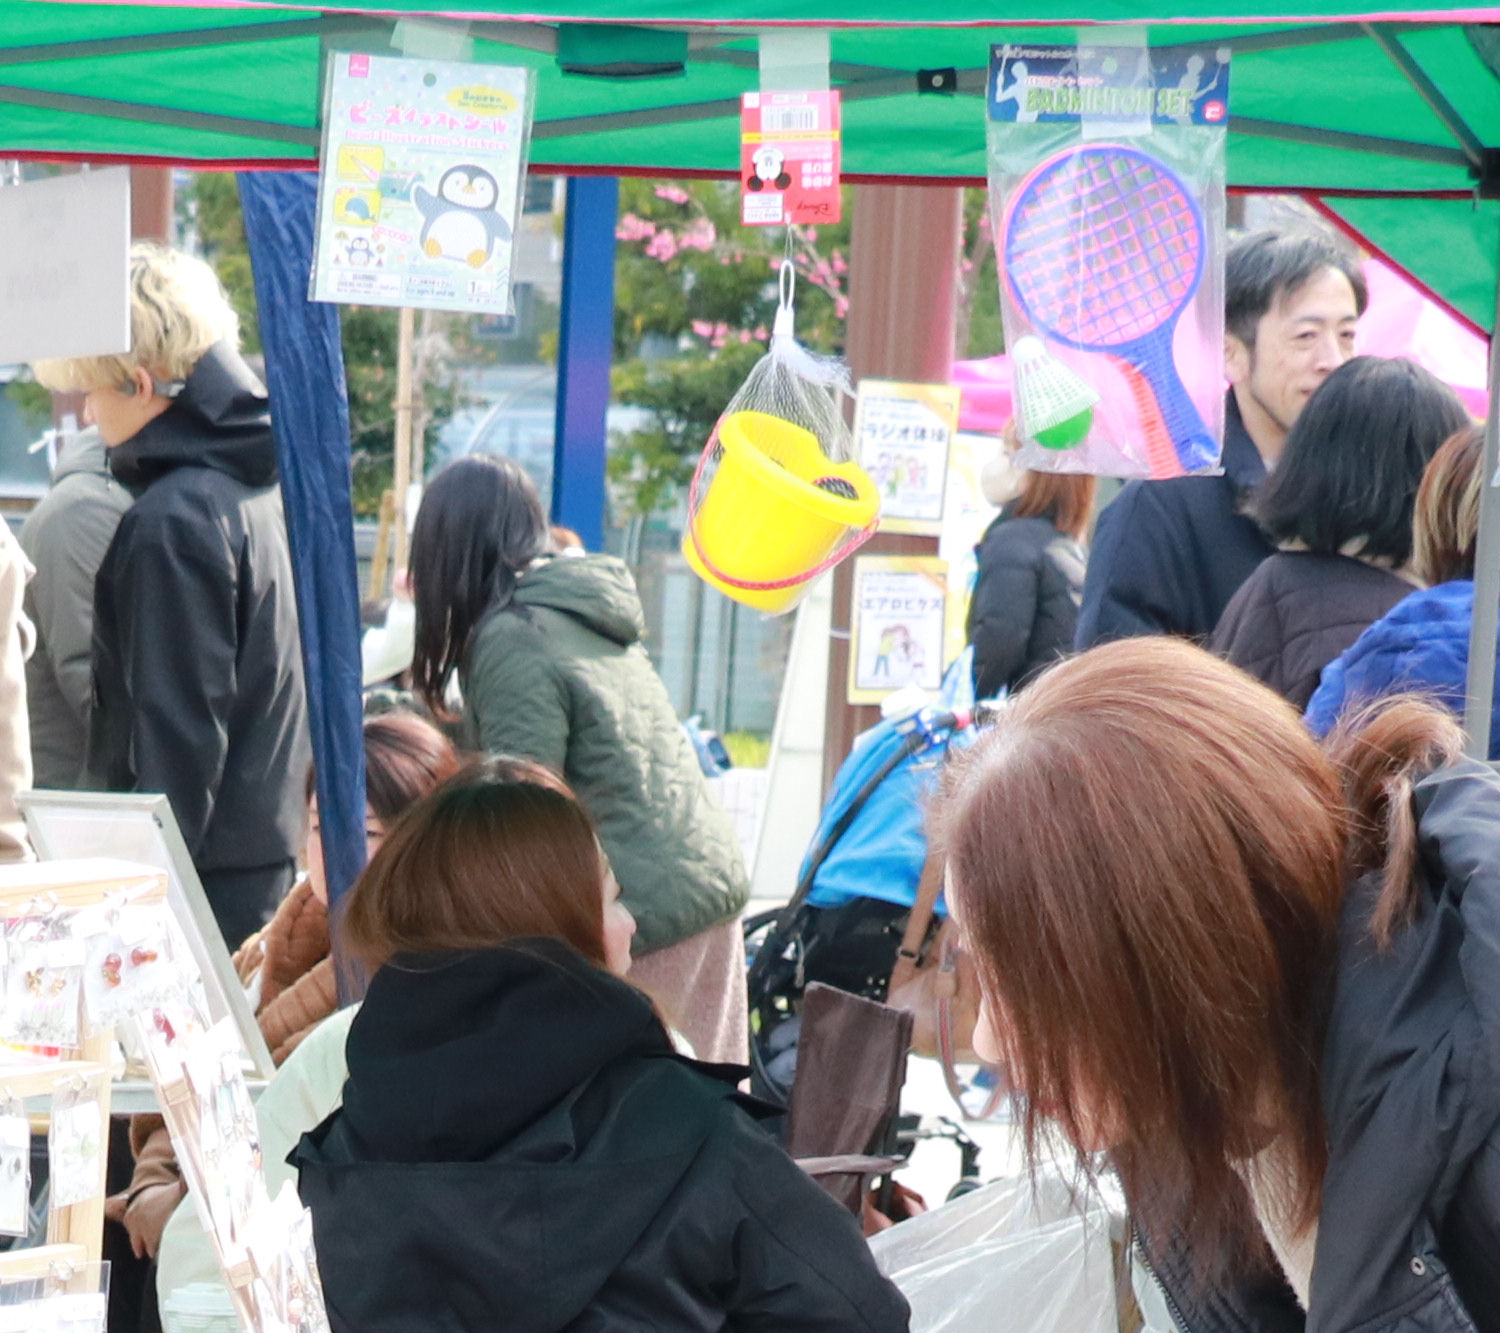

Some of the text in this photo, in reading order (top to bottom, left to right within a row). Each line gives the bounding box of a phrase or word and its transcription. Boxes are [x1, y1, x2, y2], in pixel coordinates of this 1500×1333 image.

[1024, 86, 1155, 116] BADMINTON
[1157, 87, 1194, 117] SET
[349, 101, 509, 135] ビーズイラストシール
[378, 130, 455, 146] Illustration
[455, 135, 509, 150] Stickers
